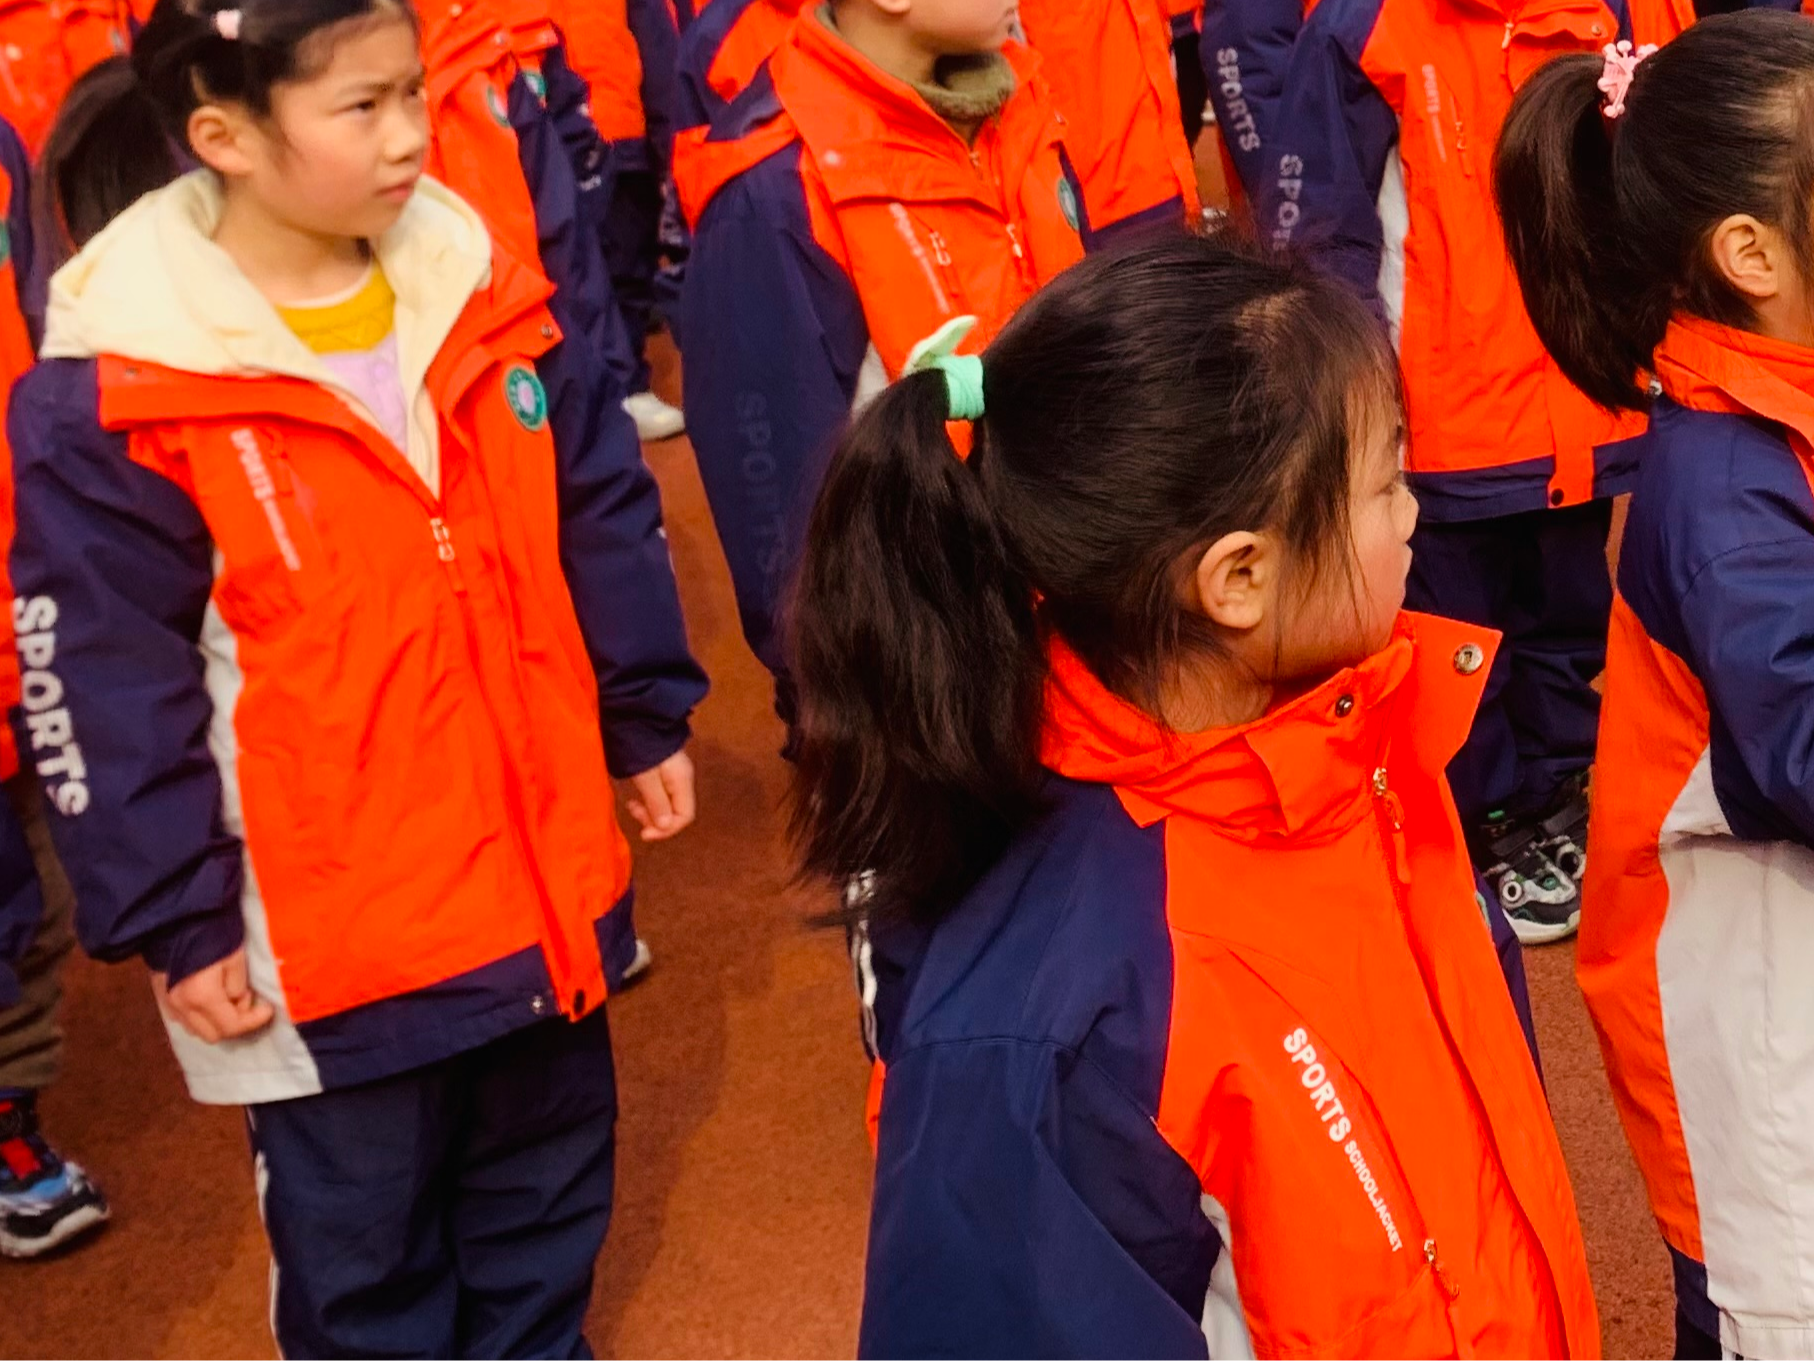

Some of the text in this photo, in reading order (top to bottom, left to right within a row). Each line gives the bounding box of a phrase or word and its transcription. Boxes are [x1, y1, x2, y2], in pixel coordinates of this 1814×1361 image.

[1216, 47, 1262, 151] SPORTS
[13, 595, 90, 817] SPORTS
[1283, 1027, 1351, 1142] SPORTS
